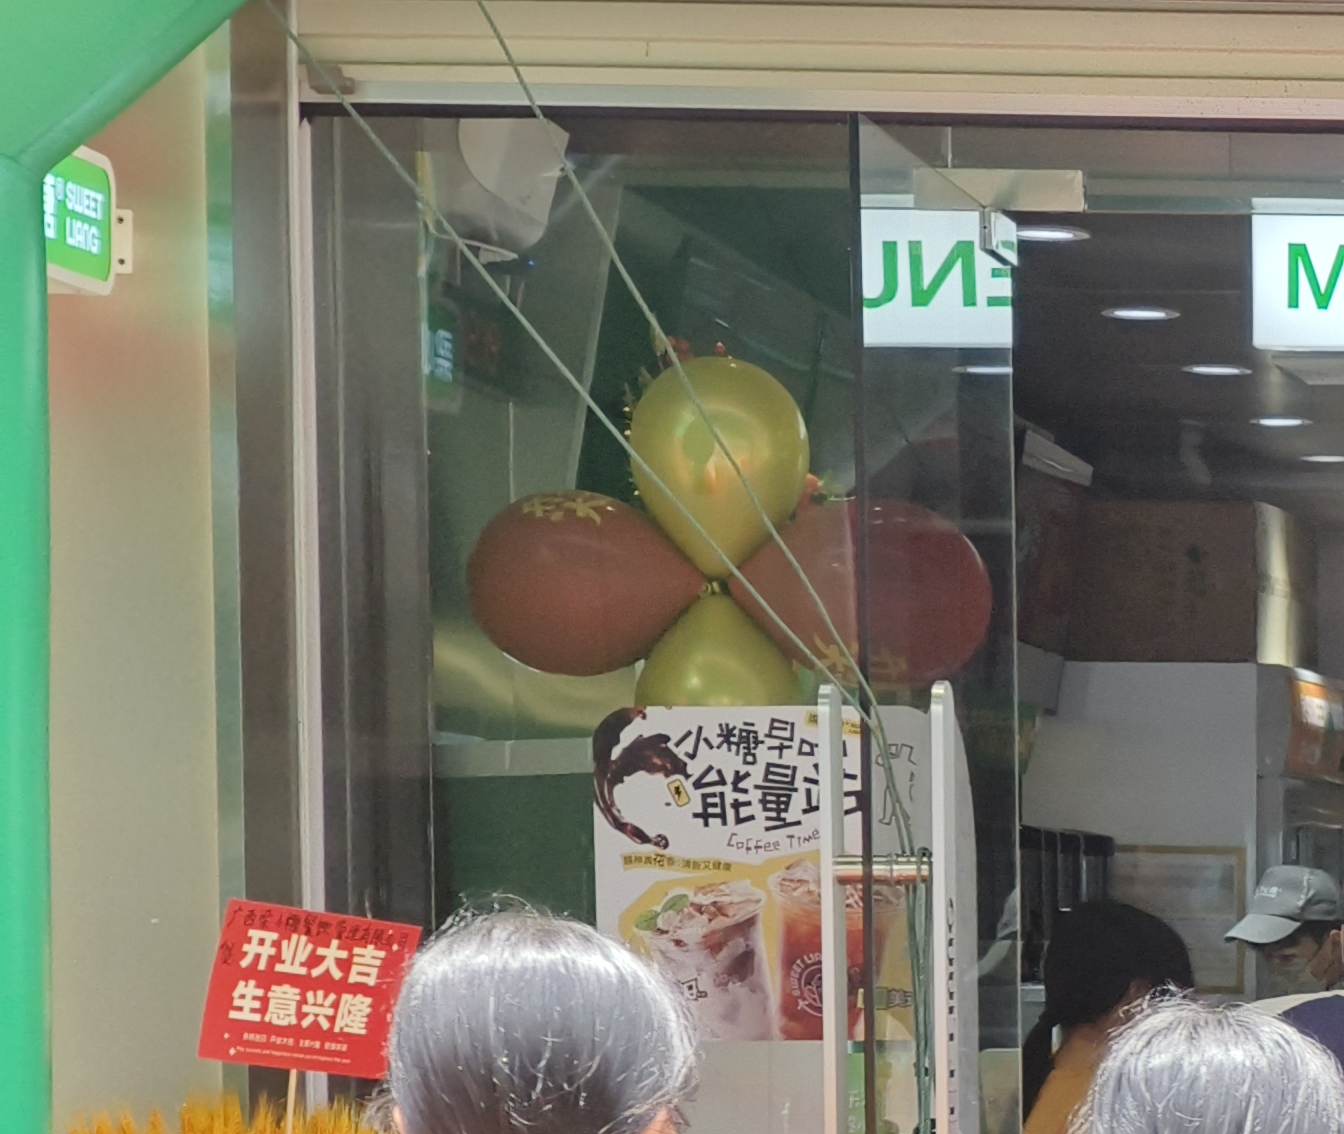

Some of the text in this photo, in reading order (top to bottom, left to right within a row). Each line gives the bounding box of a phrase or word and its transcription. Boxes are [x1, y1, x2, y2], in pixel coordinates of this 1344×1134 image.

[66, 181, 105, 221] SWEET
[66, 216, 101, 255] LIANG
[239, 928, 387, 987] 开业大吉
[227, 979, 374, 1036] 生意兴隆
